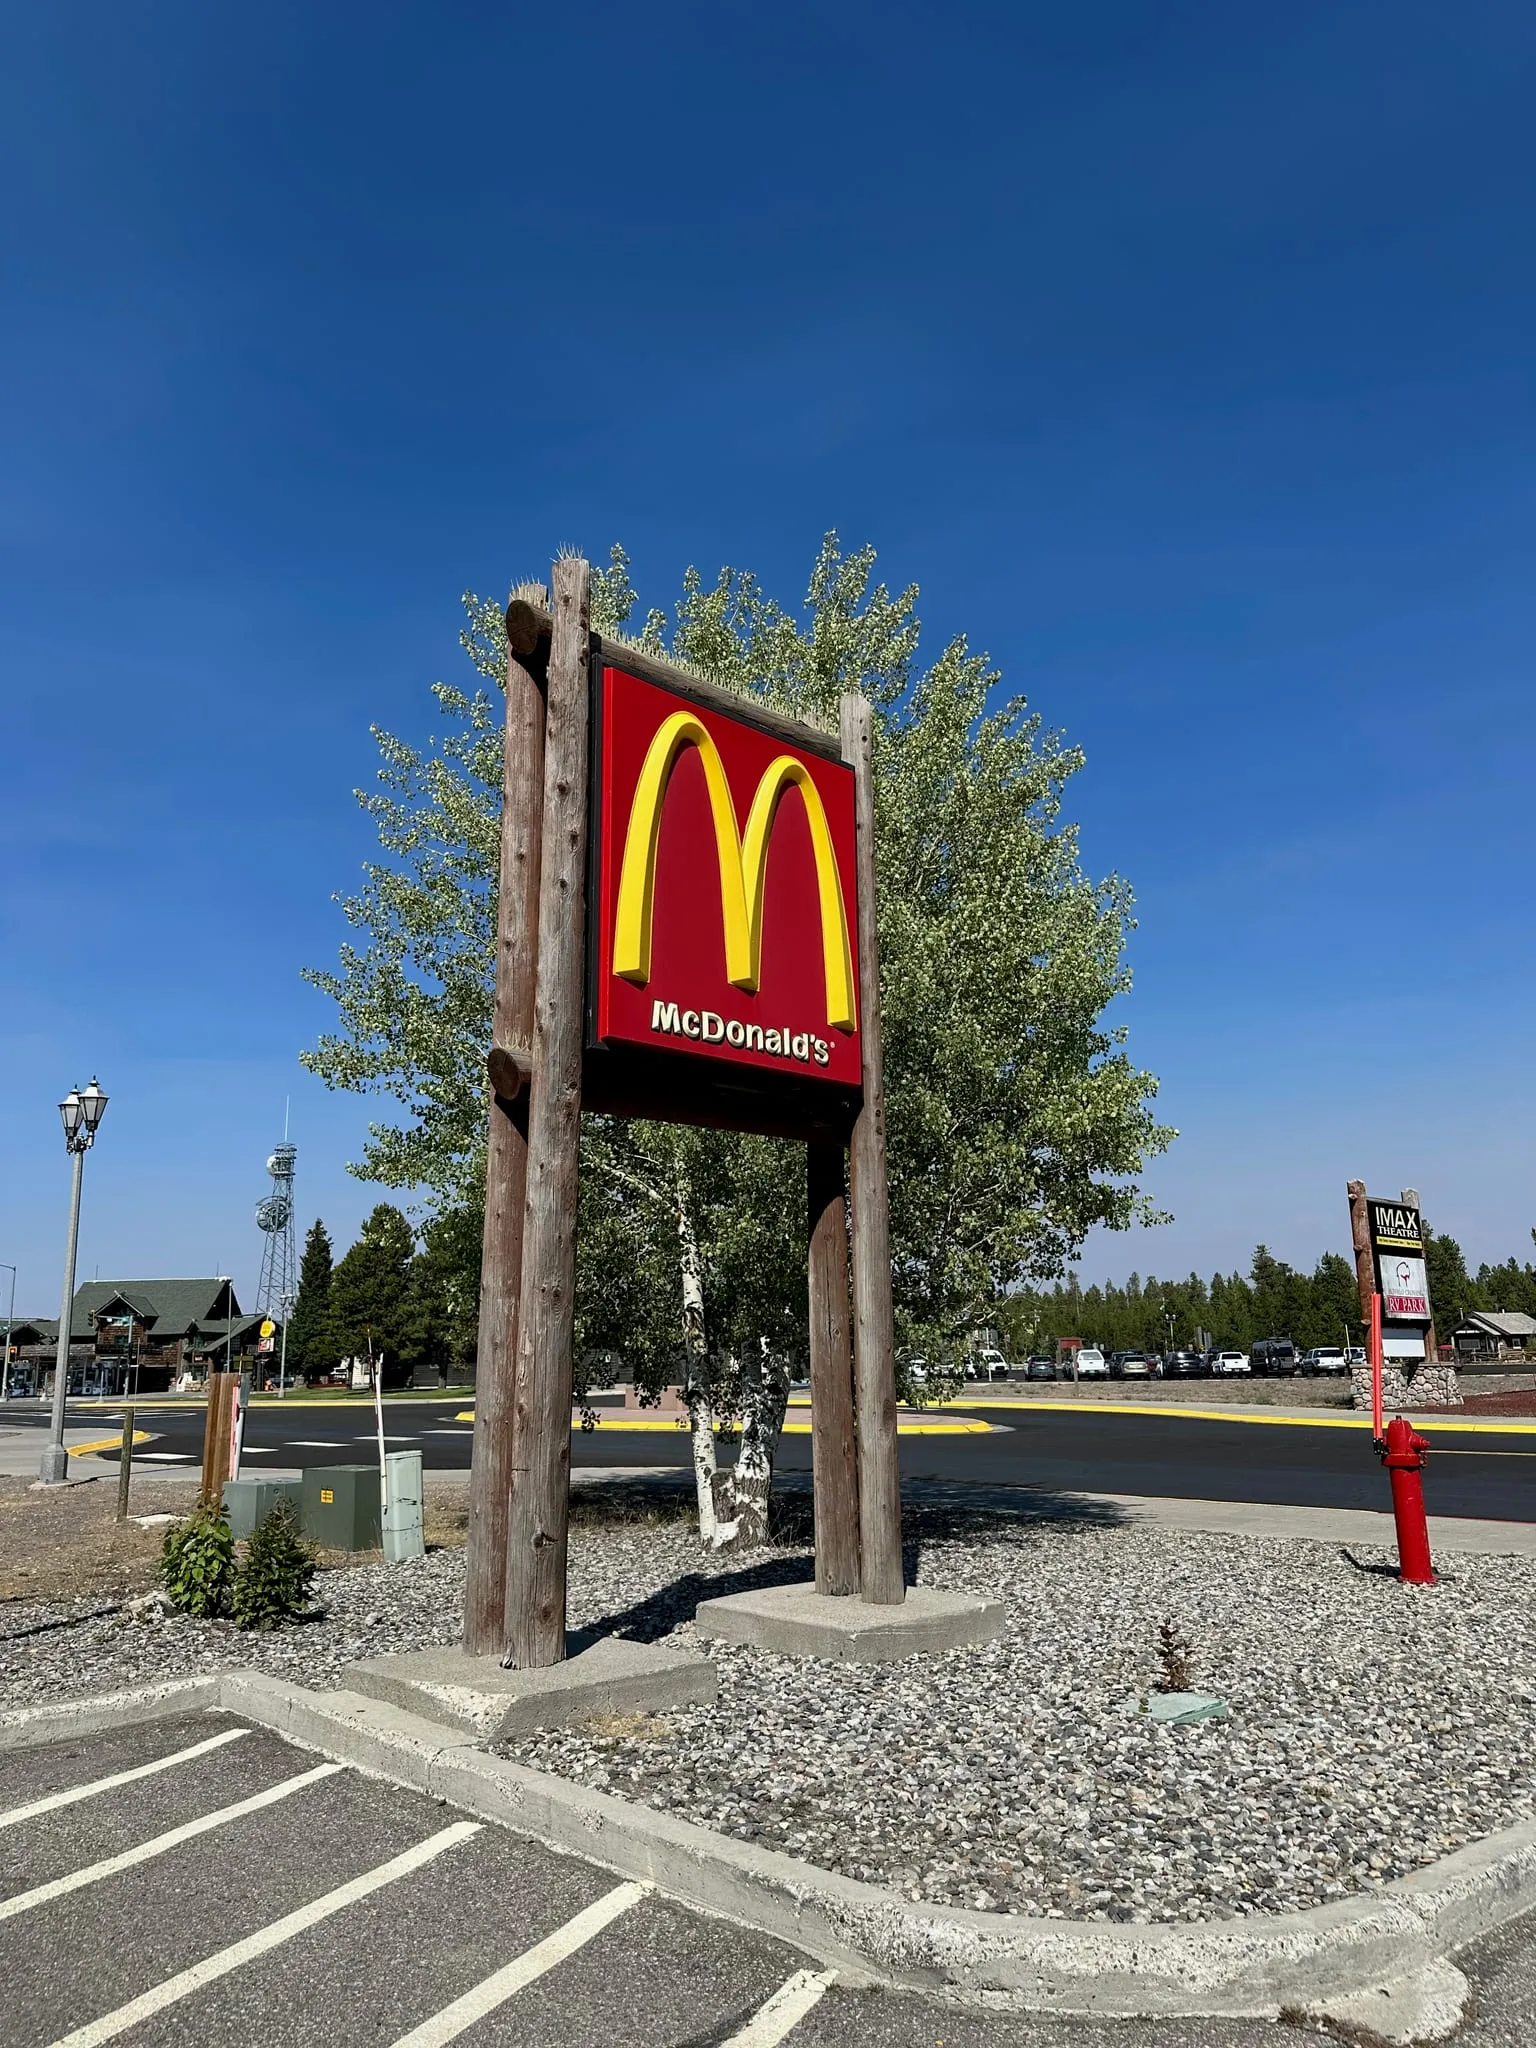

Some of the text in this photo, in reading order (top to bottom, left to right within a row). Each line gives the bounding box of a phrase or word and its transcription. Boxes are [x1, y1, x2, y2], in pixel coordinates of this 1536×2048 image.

[651, 1000, 830, 1065] McDonald's
[1375, 1206, 1418, 1231] IMAX
[1376, 1225, 1420, 1239] THEATRE
[1389, 1298, 1426, 1313] RV PARK
